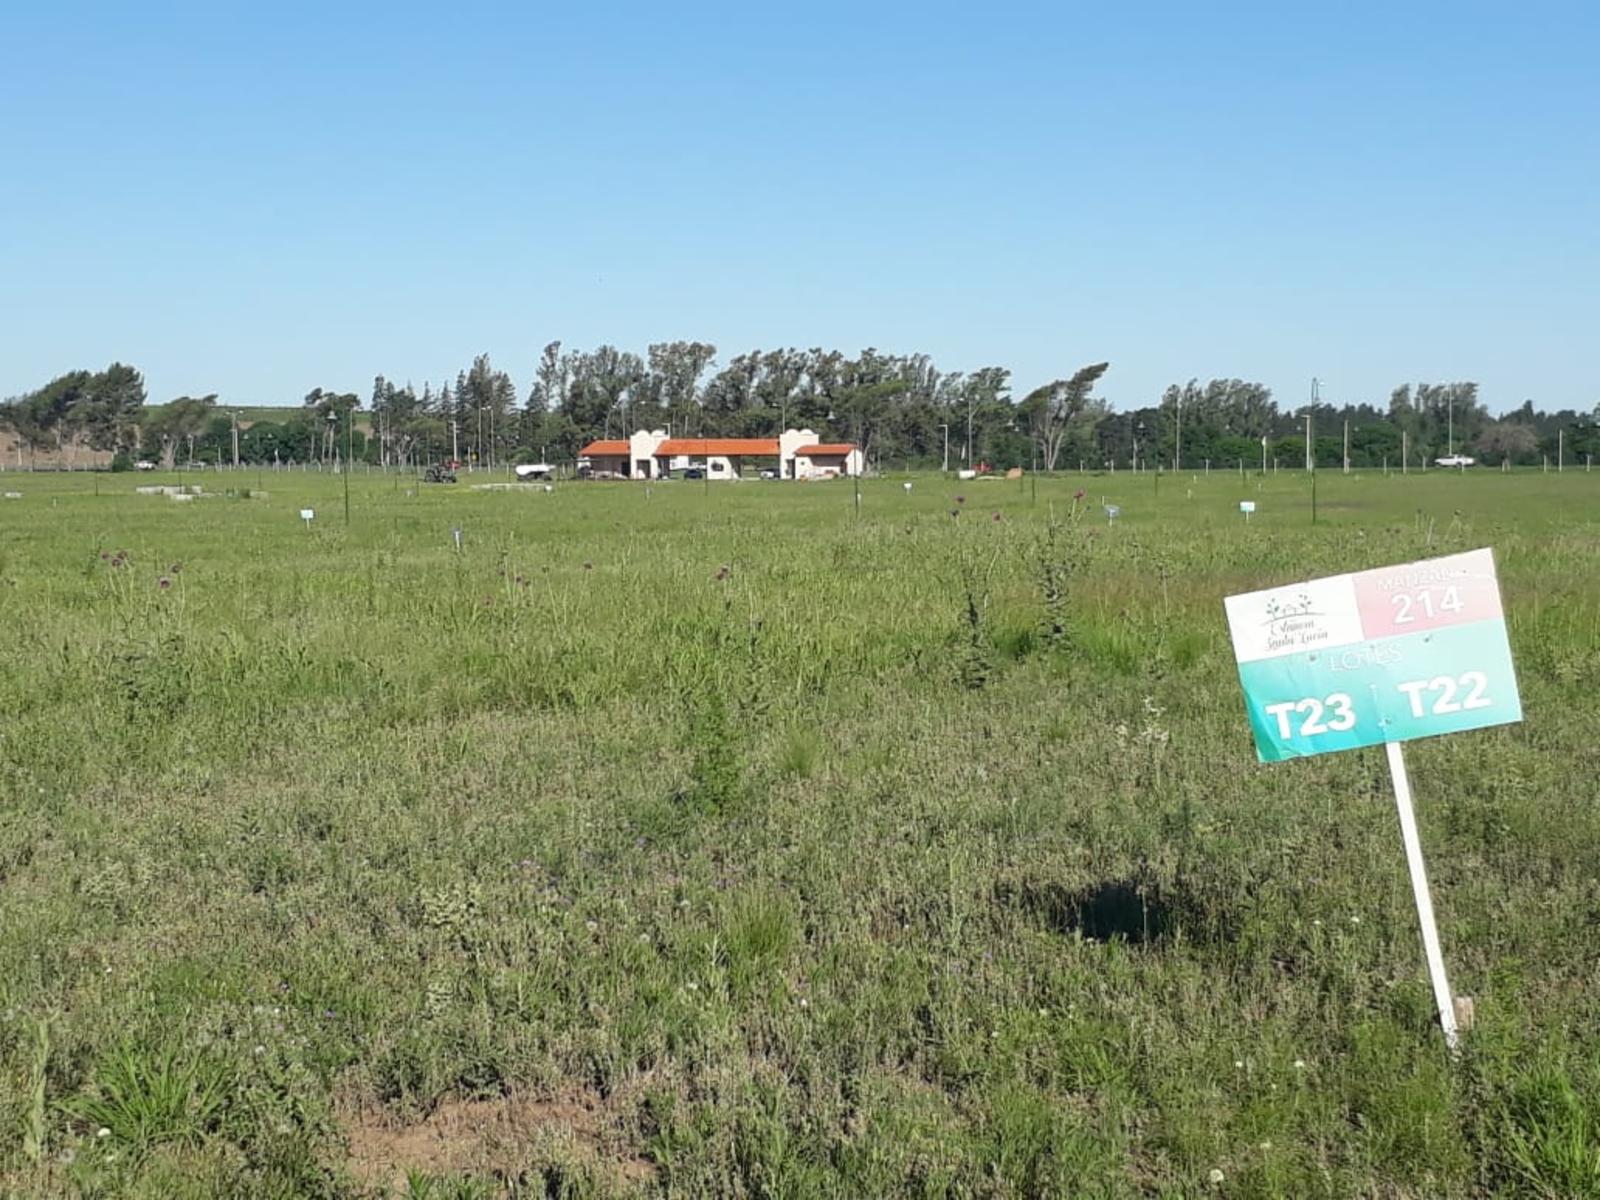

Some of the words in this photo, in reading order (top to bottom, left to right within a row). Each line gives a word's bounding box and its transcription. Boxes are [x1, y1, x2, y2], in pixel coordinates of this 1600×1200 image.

[1391, 585, 1465, 625] 214
[1329, 642, 1403, 672] LOTES
[1265, 693, 1357, 740] T23
[1397, 670, 1493, 719] T22
